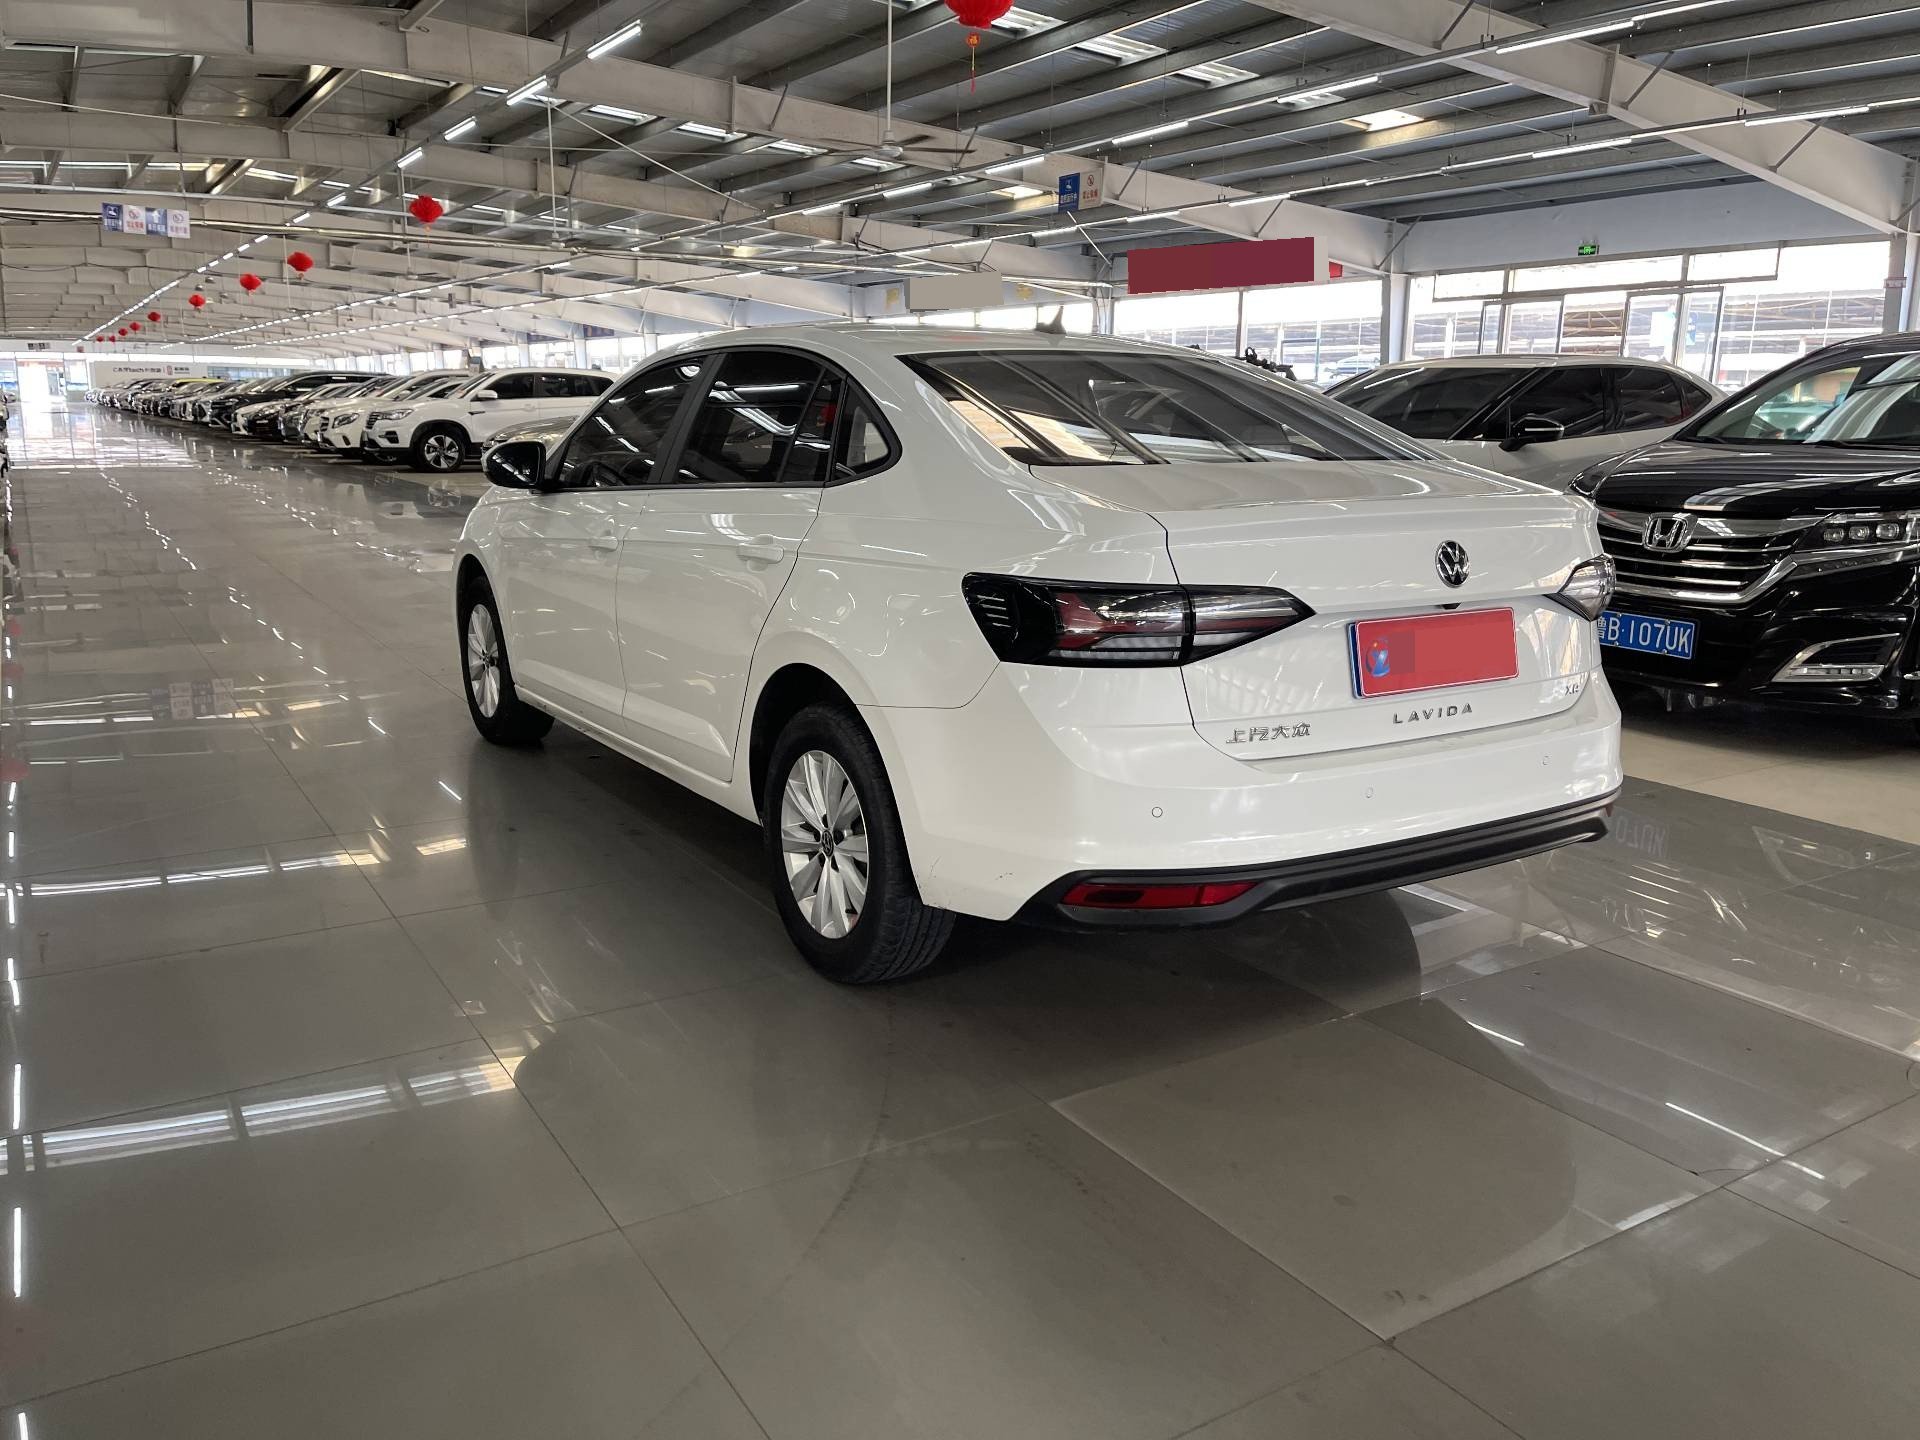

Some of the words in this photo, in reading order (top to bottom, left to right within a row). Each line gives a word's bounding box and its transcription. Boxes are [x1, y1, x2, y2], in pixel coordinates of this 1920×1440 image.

[1393, 703, 1473, 724] LAVIDA
[1225, 722, 1311, 744] 上汽大众
